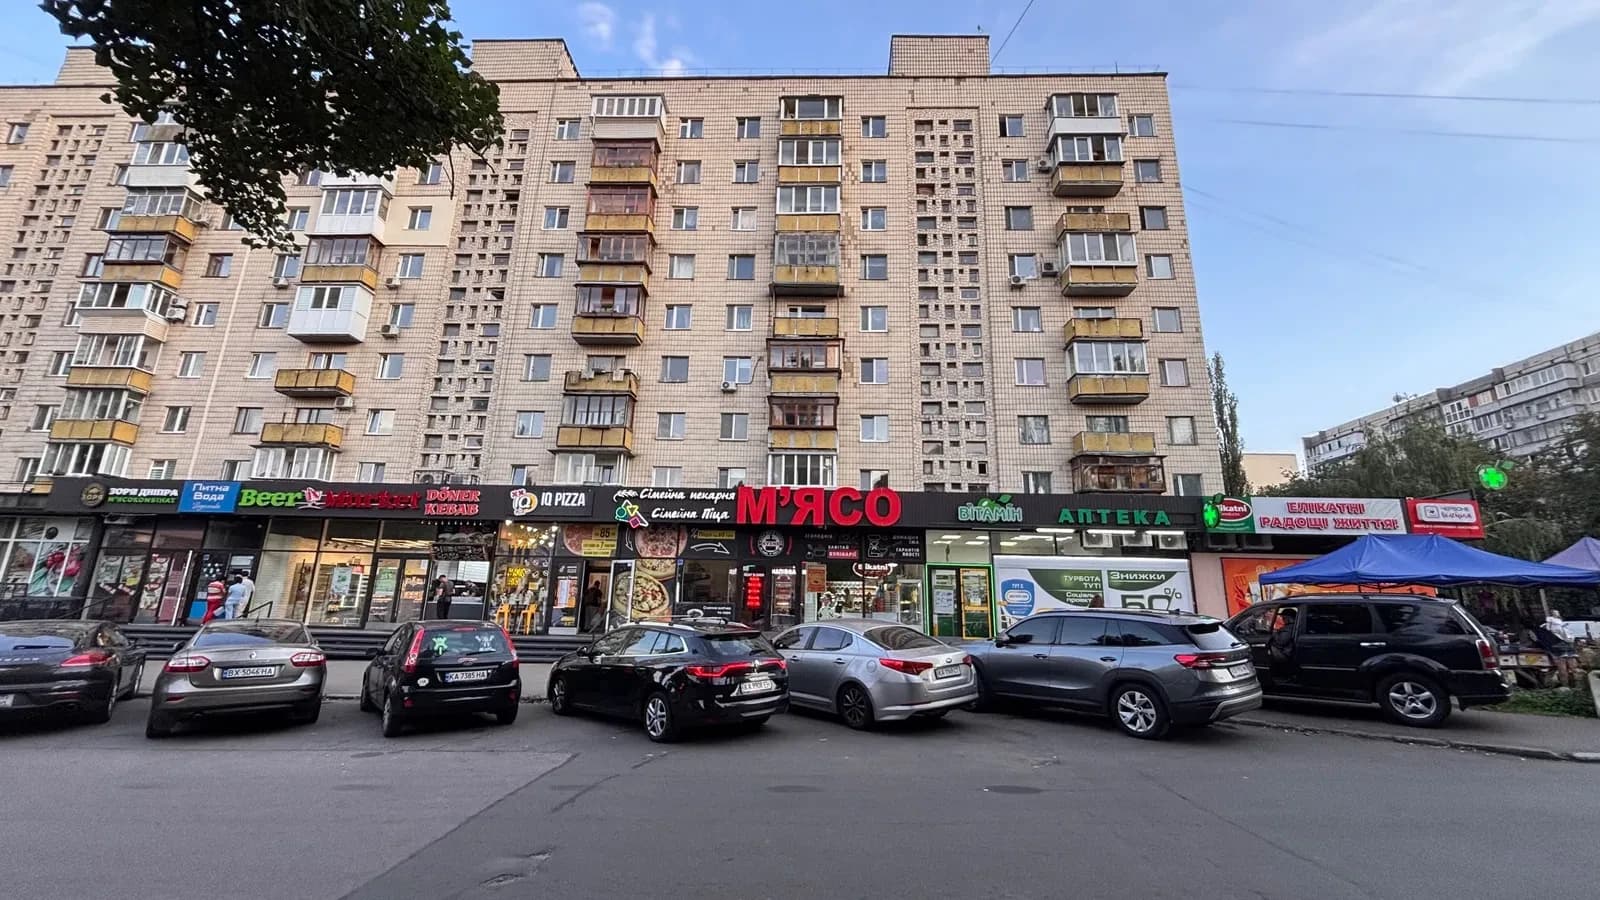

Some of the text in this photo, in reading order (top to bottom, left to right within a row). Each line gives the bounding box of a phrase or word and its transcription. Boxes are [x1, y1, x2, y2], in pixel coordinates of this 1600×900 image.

[192, 483, 230, 492] Питна
[426, 486, 481, 502] DÖNER
[192, 492, 225, 502] Вода
[238, 489, 303, 507] Beer
[325, 490, 422, 510] Market
[540, 492, 586, 507] IQ PIZZA
[640, 488, 736, 504] Сімейна пекарня
[423, 503, 479, 516] KEBAB
[651, 507, 730, 523] Сімейна Піца
[1286, 502, 1366, 514] ЕЛІКАТНІ
[1058, 508, 1172, 526] АПТЕКА
[1259, 516, 1329, 530] РАДОЩІ
[1333, 518, 1399, 530] ЖИТТЯ!
[1063, 575, 1101, 583] ТУРБОТА
